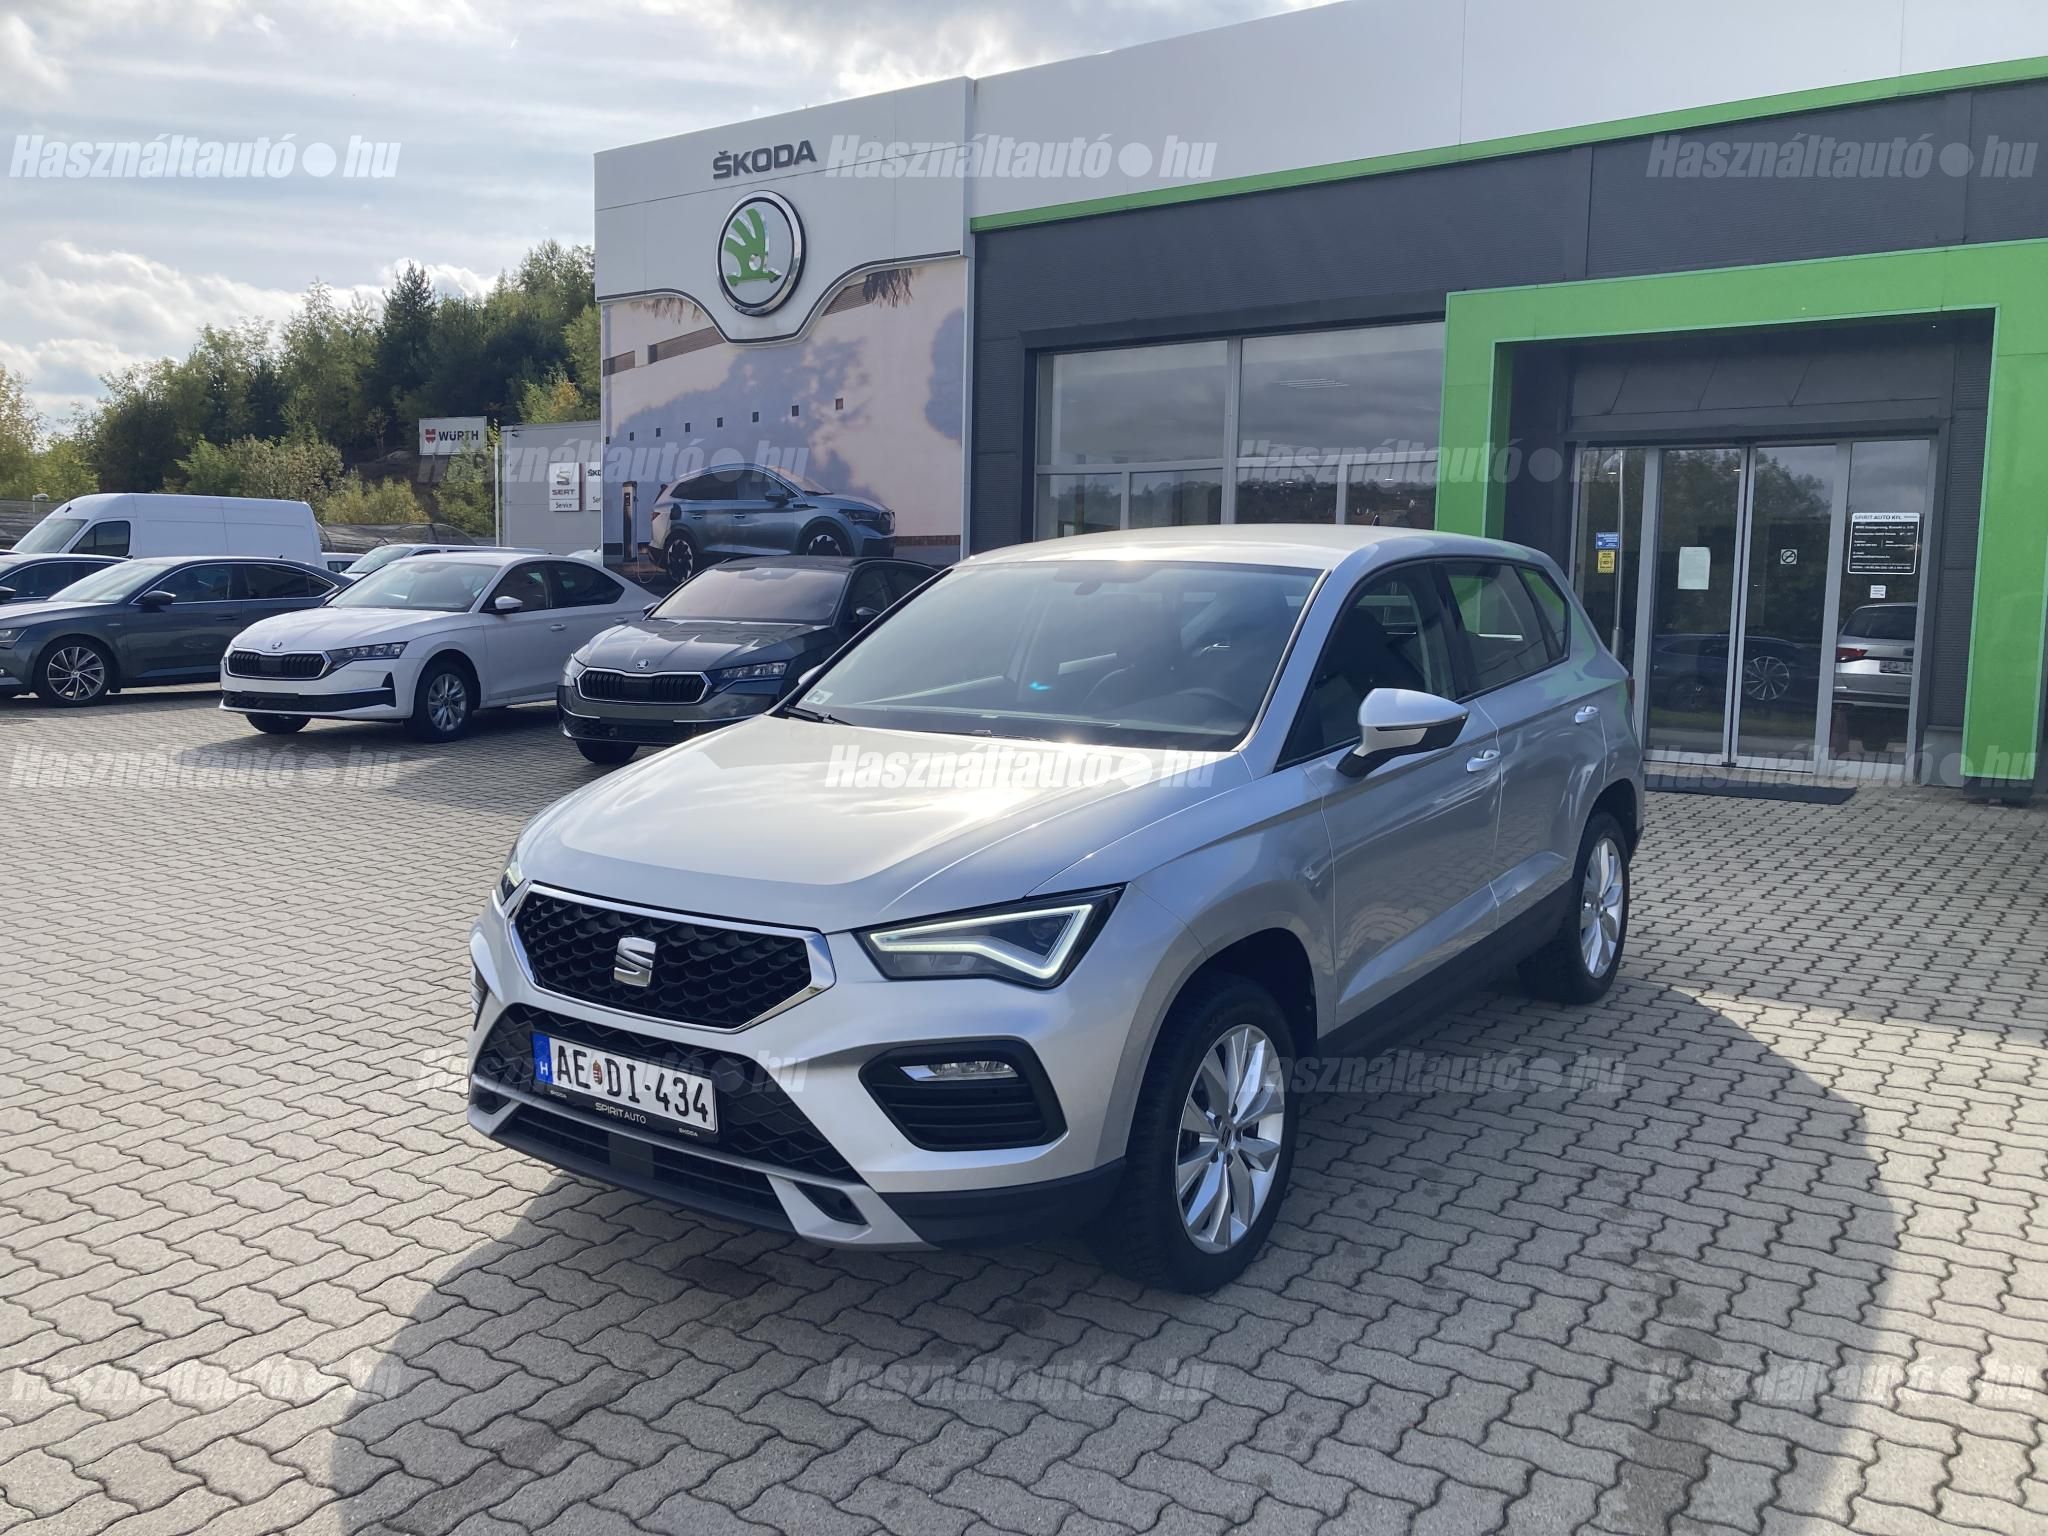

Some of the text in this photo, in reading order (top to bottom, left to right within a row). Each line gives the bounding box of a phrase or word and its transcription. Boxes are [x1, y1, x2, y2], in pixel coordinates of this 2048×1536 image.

[713, 140, 817, 180] ŠKODA
[438, 430, 479, 441] WÜRTH
[595, 1102, 647, 1125] SPIRIT AUTO
